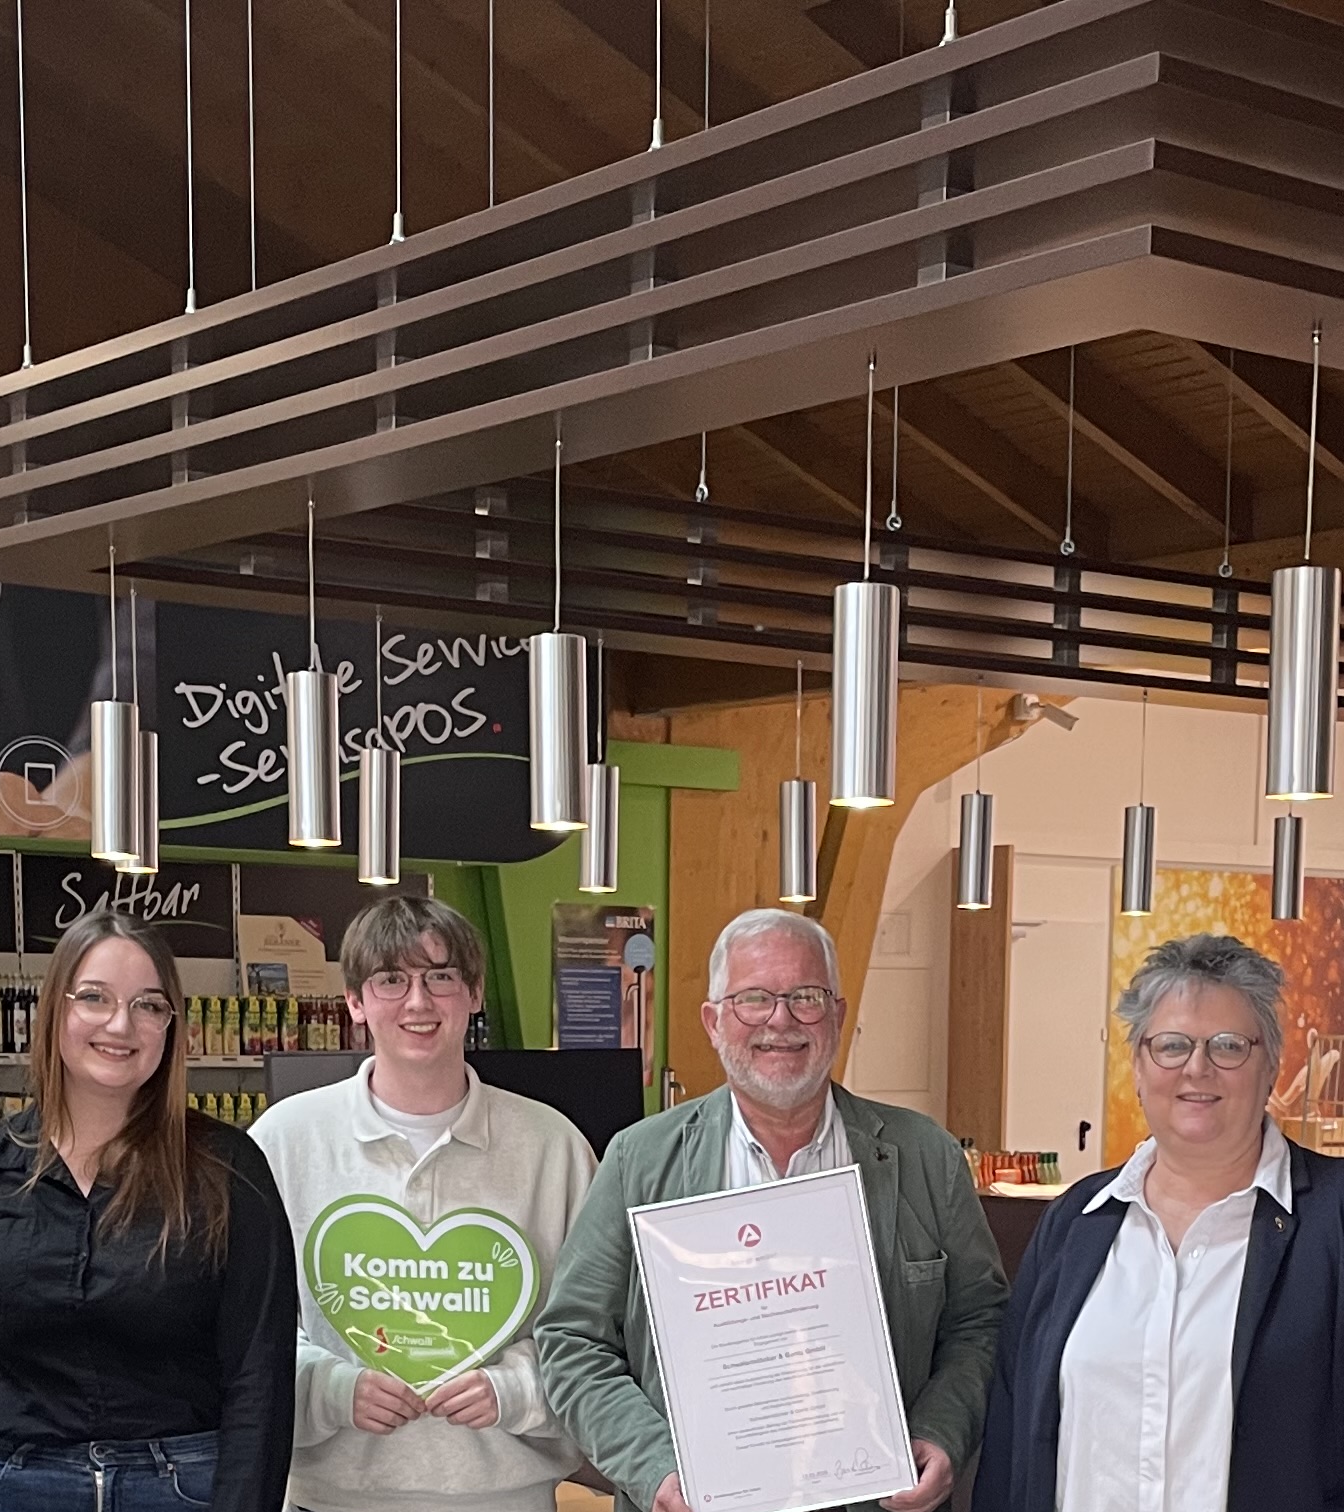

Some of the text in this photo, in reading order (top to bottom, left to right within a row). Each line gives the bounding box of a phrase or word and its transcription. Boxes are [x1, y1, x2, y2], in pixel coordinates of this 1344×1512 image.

[174, 642, 362, 734] Digitle
[615, 915, 647, 929] BRITA
[344, 1252, 494, 1282] Komm zu
[348, 1285, 491, 1313] Schwalli
[693, 1269, 828, 1312] ZERTIFIKAT
